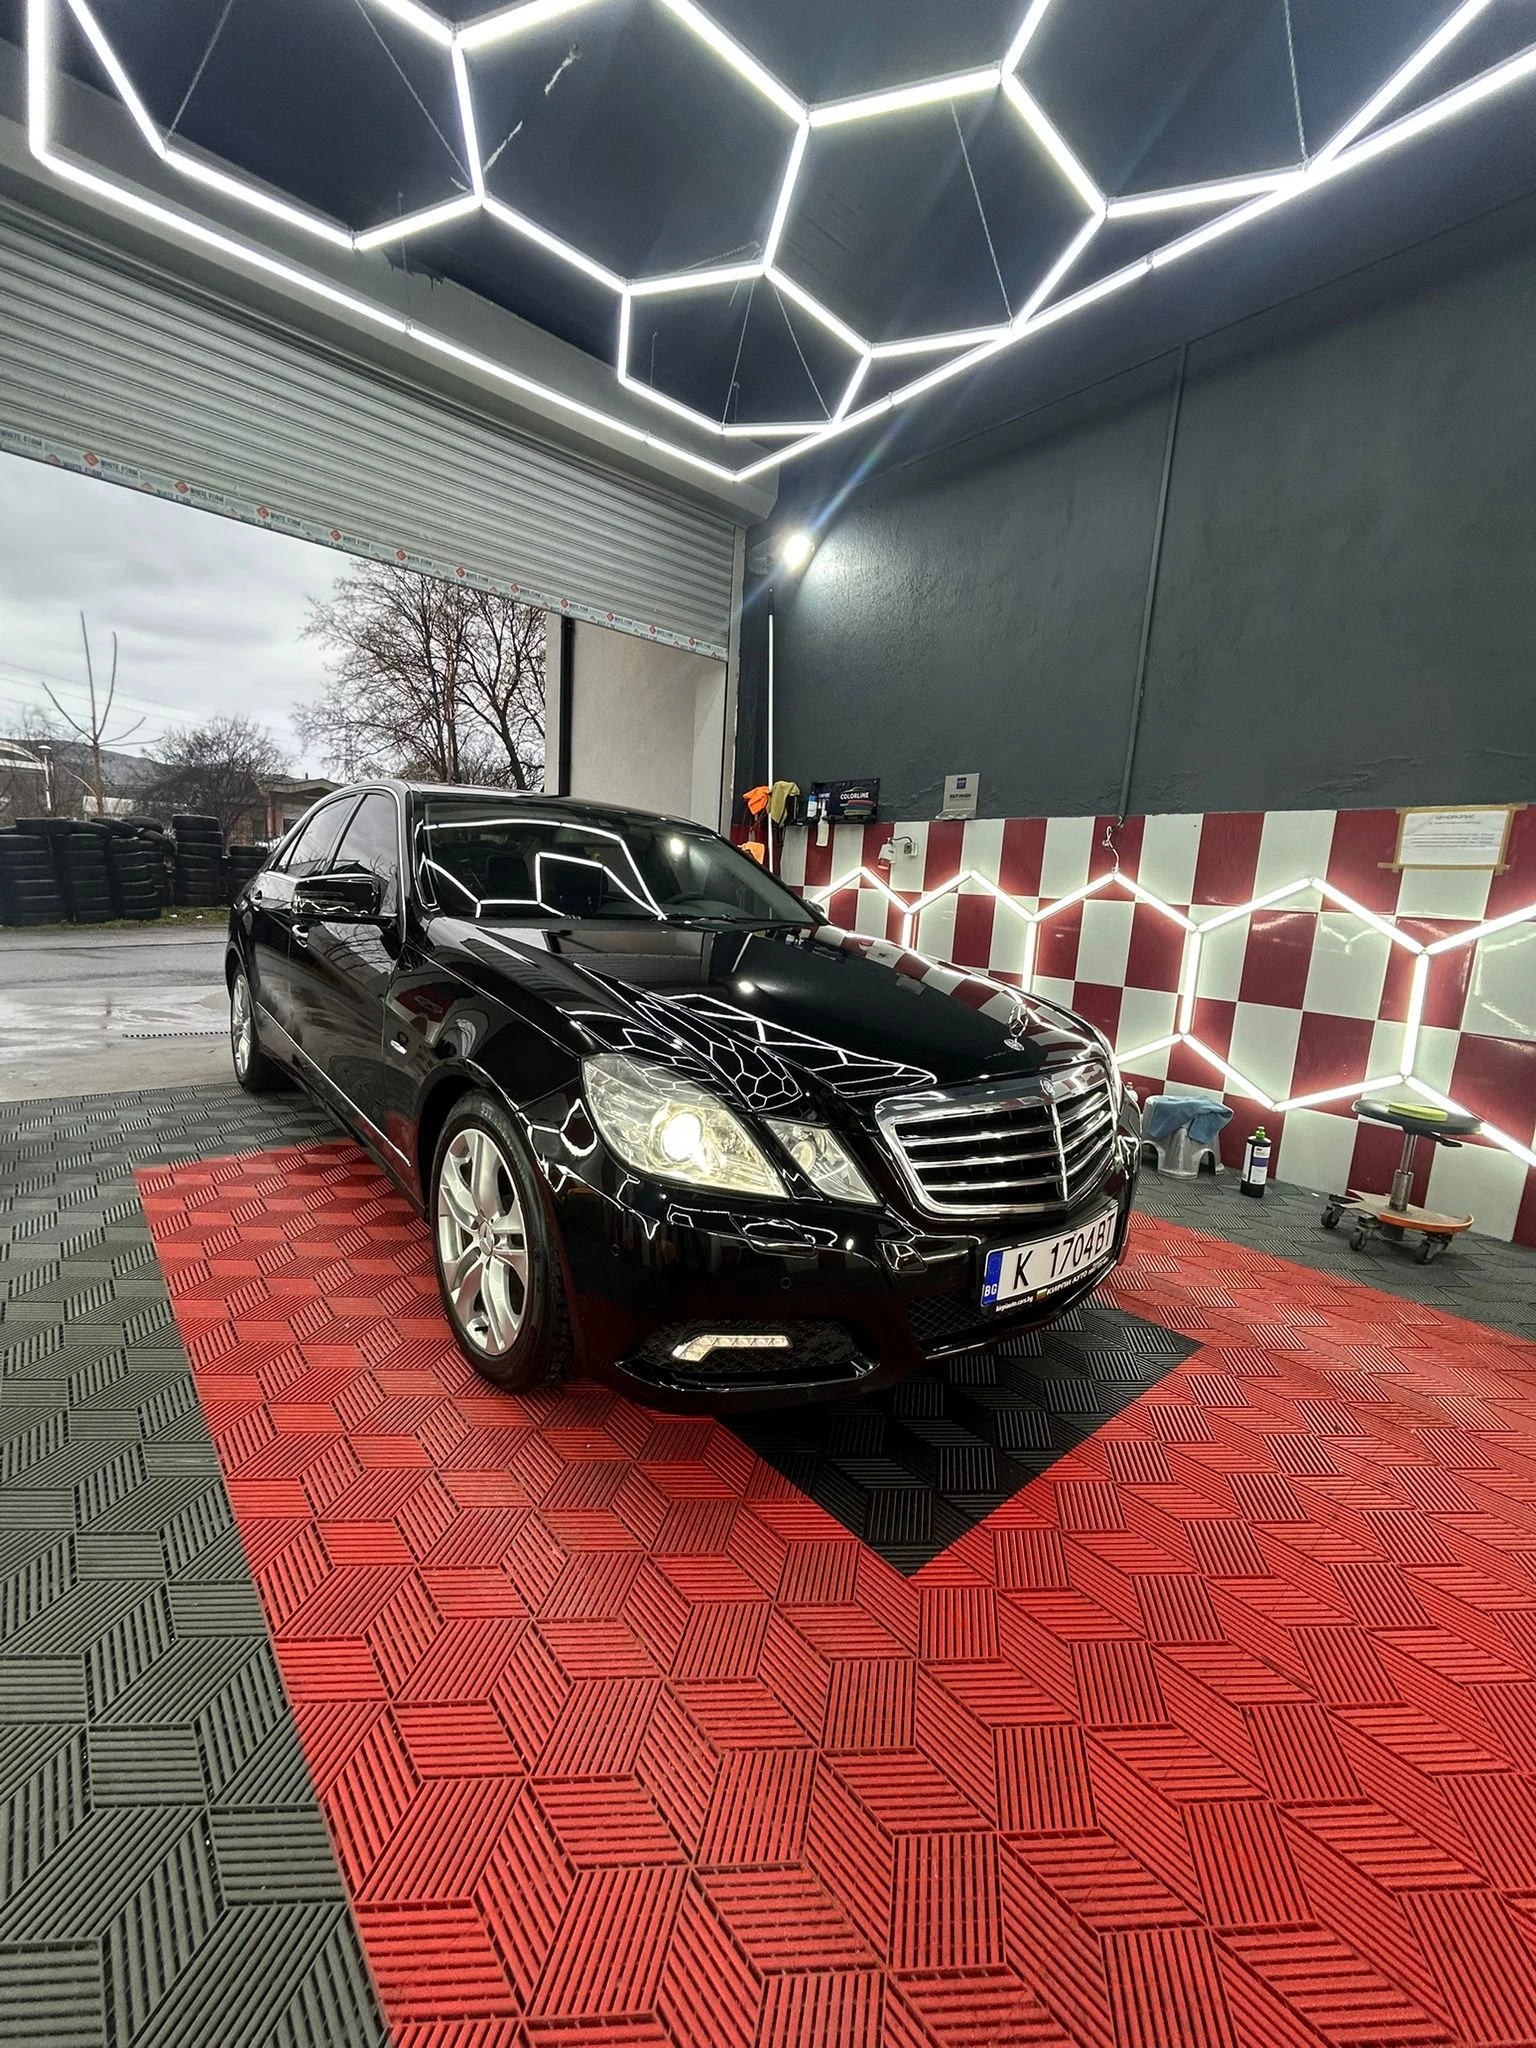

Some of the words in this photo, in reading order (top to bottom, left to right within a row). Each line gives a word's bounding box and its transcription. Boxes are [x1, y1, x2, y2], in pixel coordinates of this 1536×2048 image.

[840, 792, 870, 800] COLORLINE
[1013, 1249, 1034, 1290] K
[984, 1283, 998, 1298] BG
